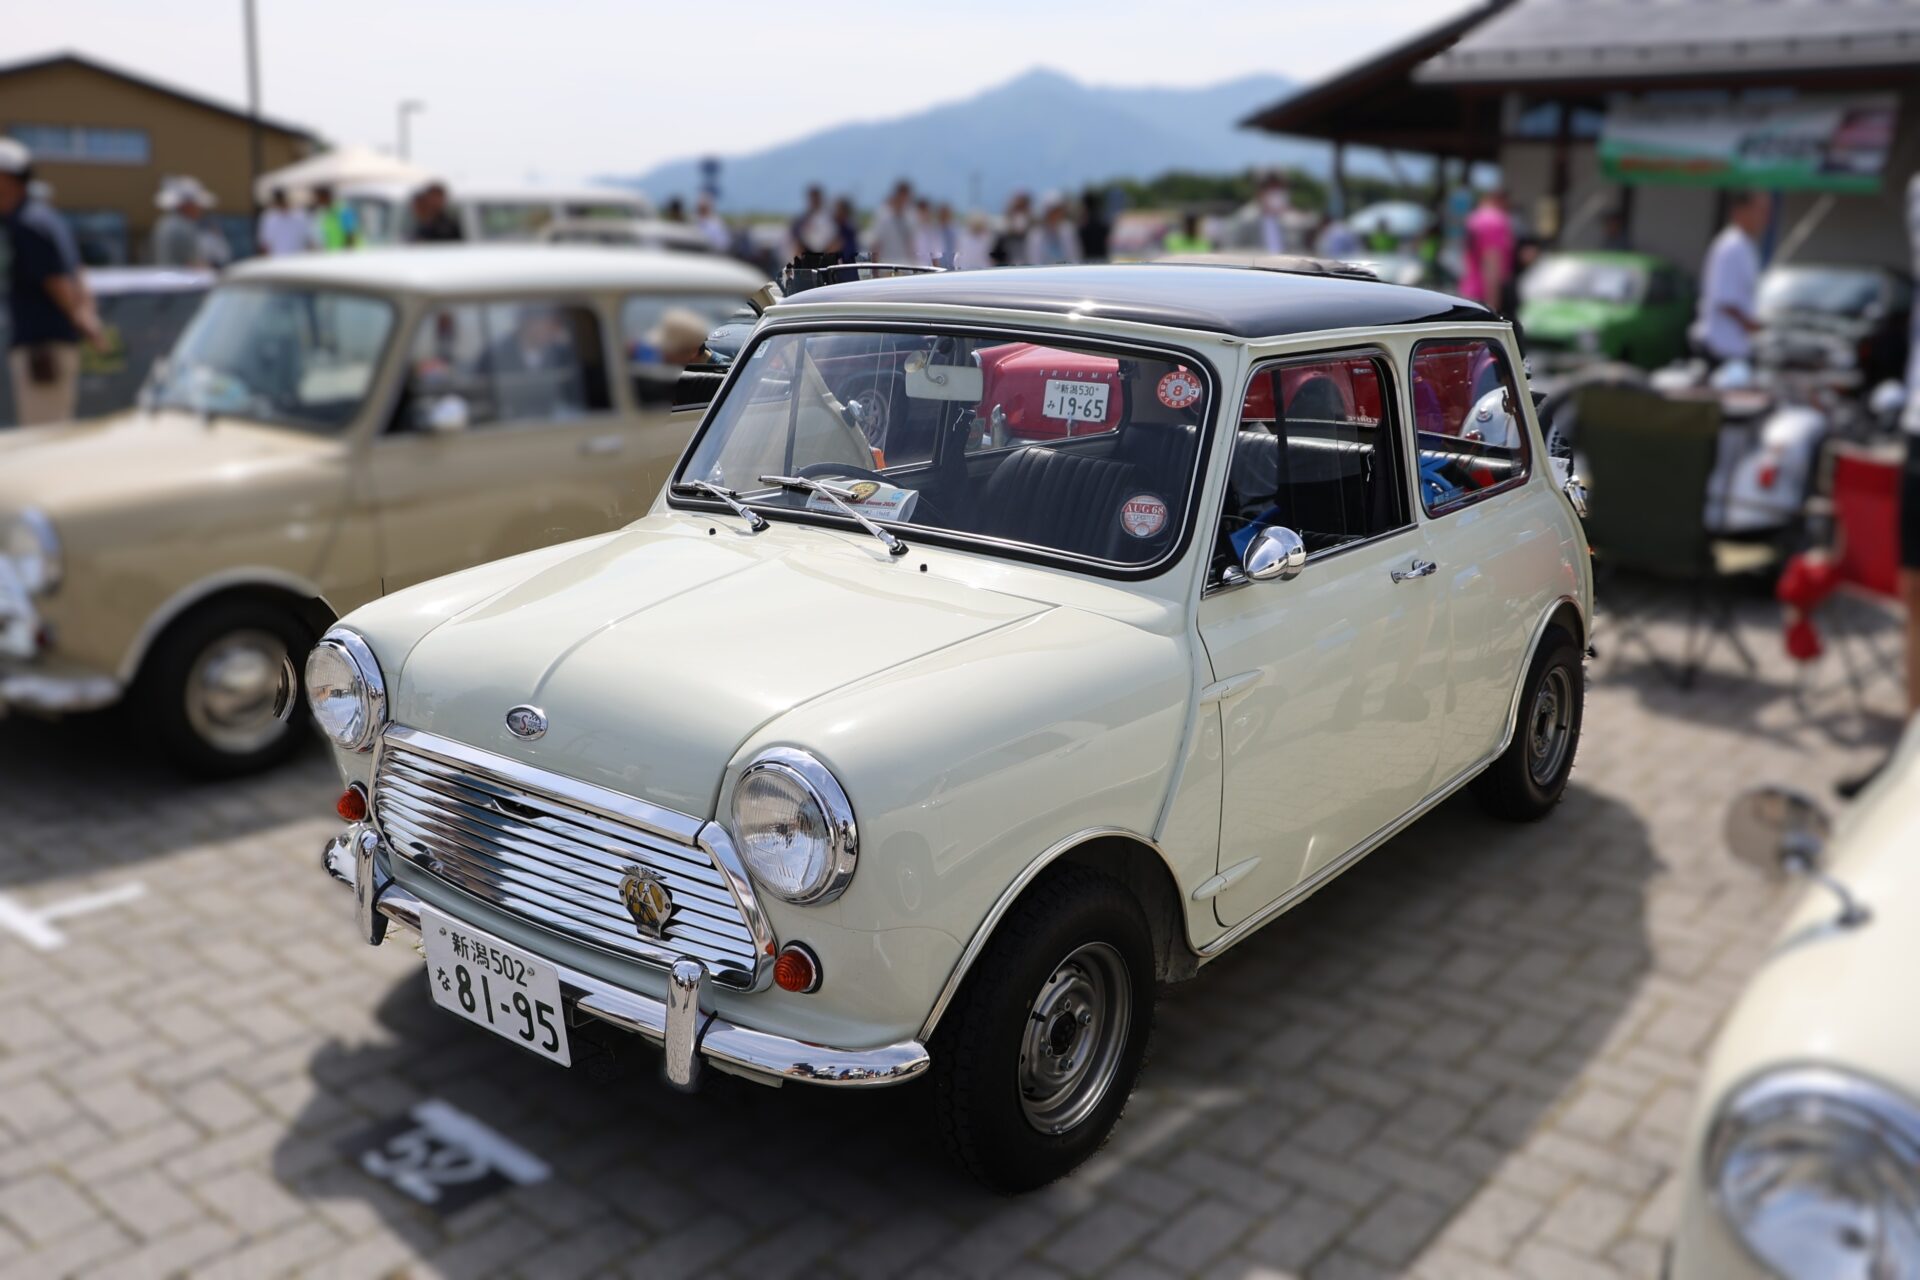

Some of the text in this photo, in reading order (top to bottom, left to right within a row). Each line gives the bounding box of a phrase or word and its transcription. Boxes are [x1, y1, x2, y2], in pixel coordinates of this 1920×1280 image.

[1040, 370, 1113, 380] TRIUMP
[1061, 384, 1095, 397] 新潟530
[1173, 385, 1183, 397] 8
[1059, 396, 1104, 419] 19-65
[1125, 503, 1164, 514] AUG 68
[450, 931, 528, 988] 新潟502
[436, 964, 560, 1053] な 81-95
